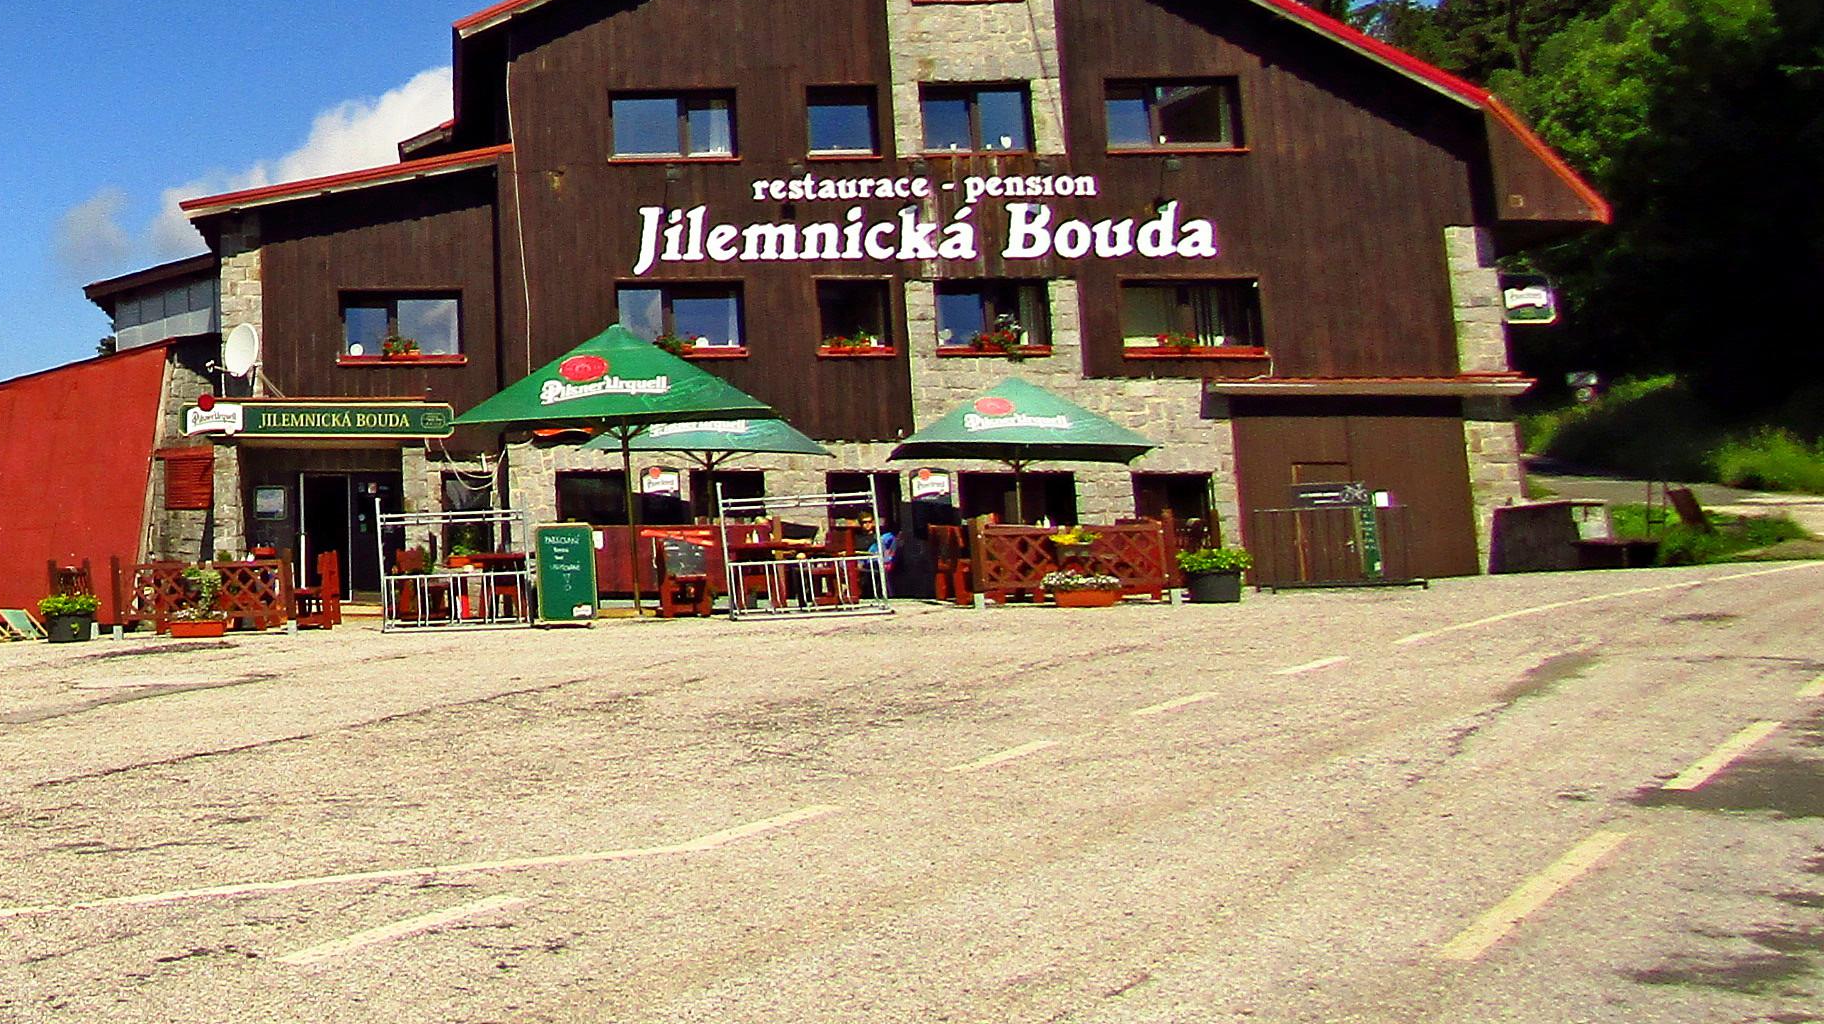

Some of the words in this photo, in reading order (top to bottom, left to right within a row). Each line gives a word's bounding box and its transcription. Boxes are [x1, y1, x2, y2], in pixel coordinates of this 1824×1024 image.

[752, 172, 929, 200] restaurace
[964, 175, 1097, 203] pension
[633, 205, 977, 275] Jilemnická
[1002, 200, 1217, 259] Bouda
[540, 379, 605, 404] Pilsner
[603, 375, 671, 395] Urquell
[258, 410, 351, 429] JILEMNICKÁ
[356, 413, 410, 427] BOUDA
